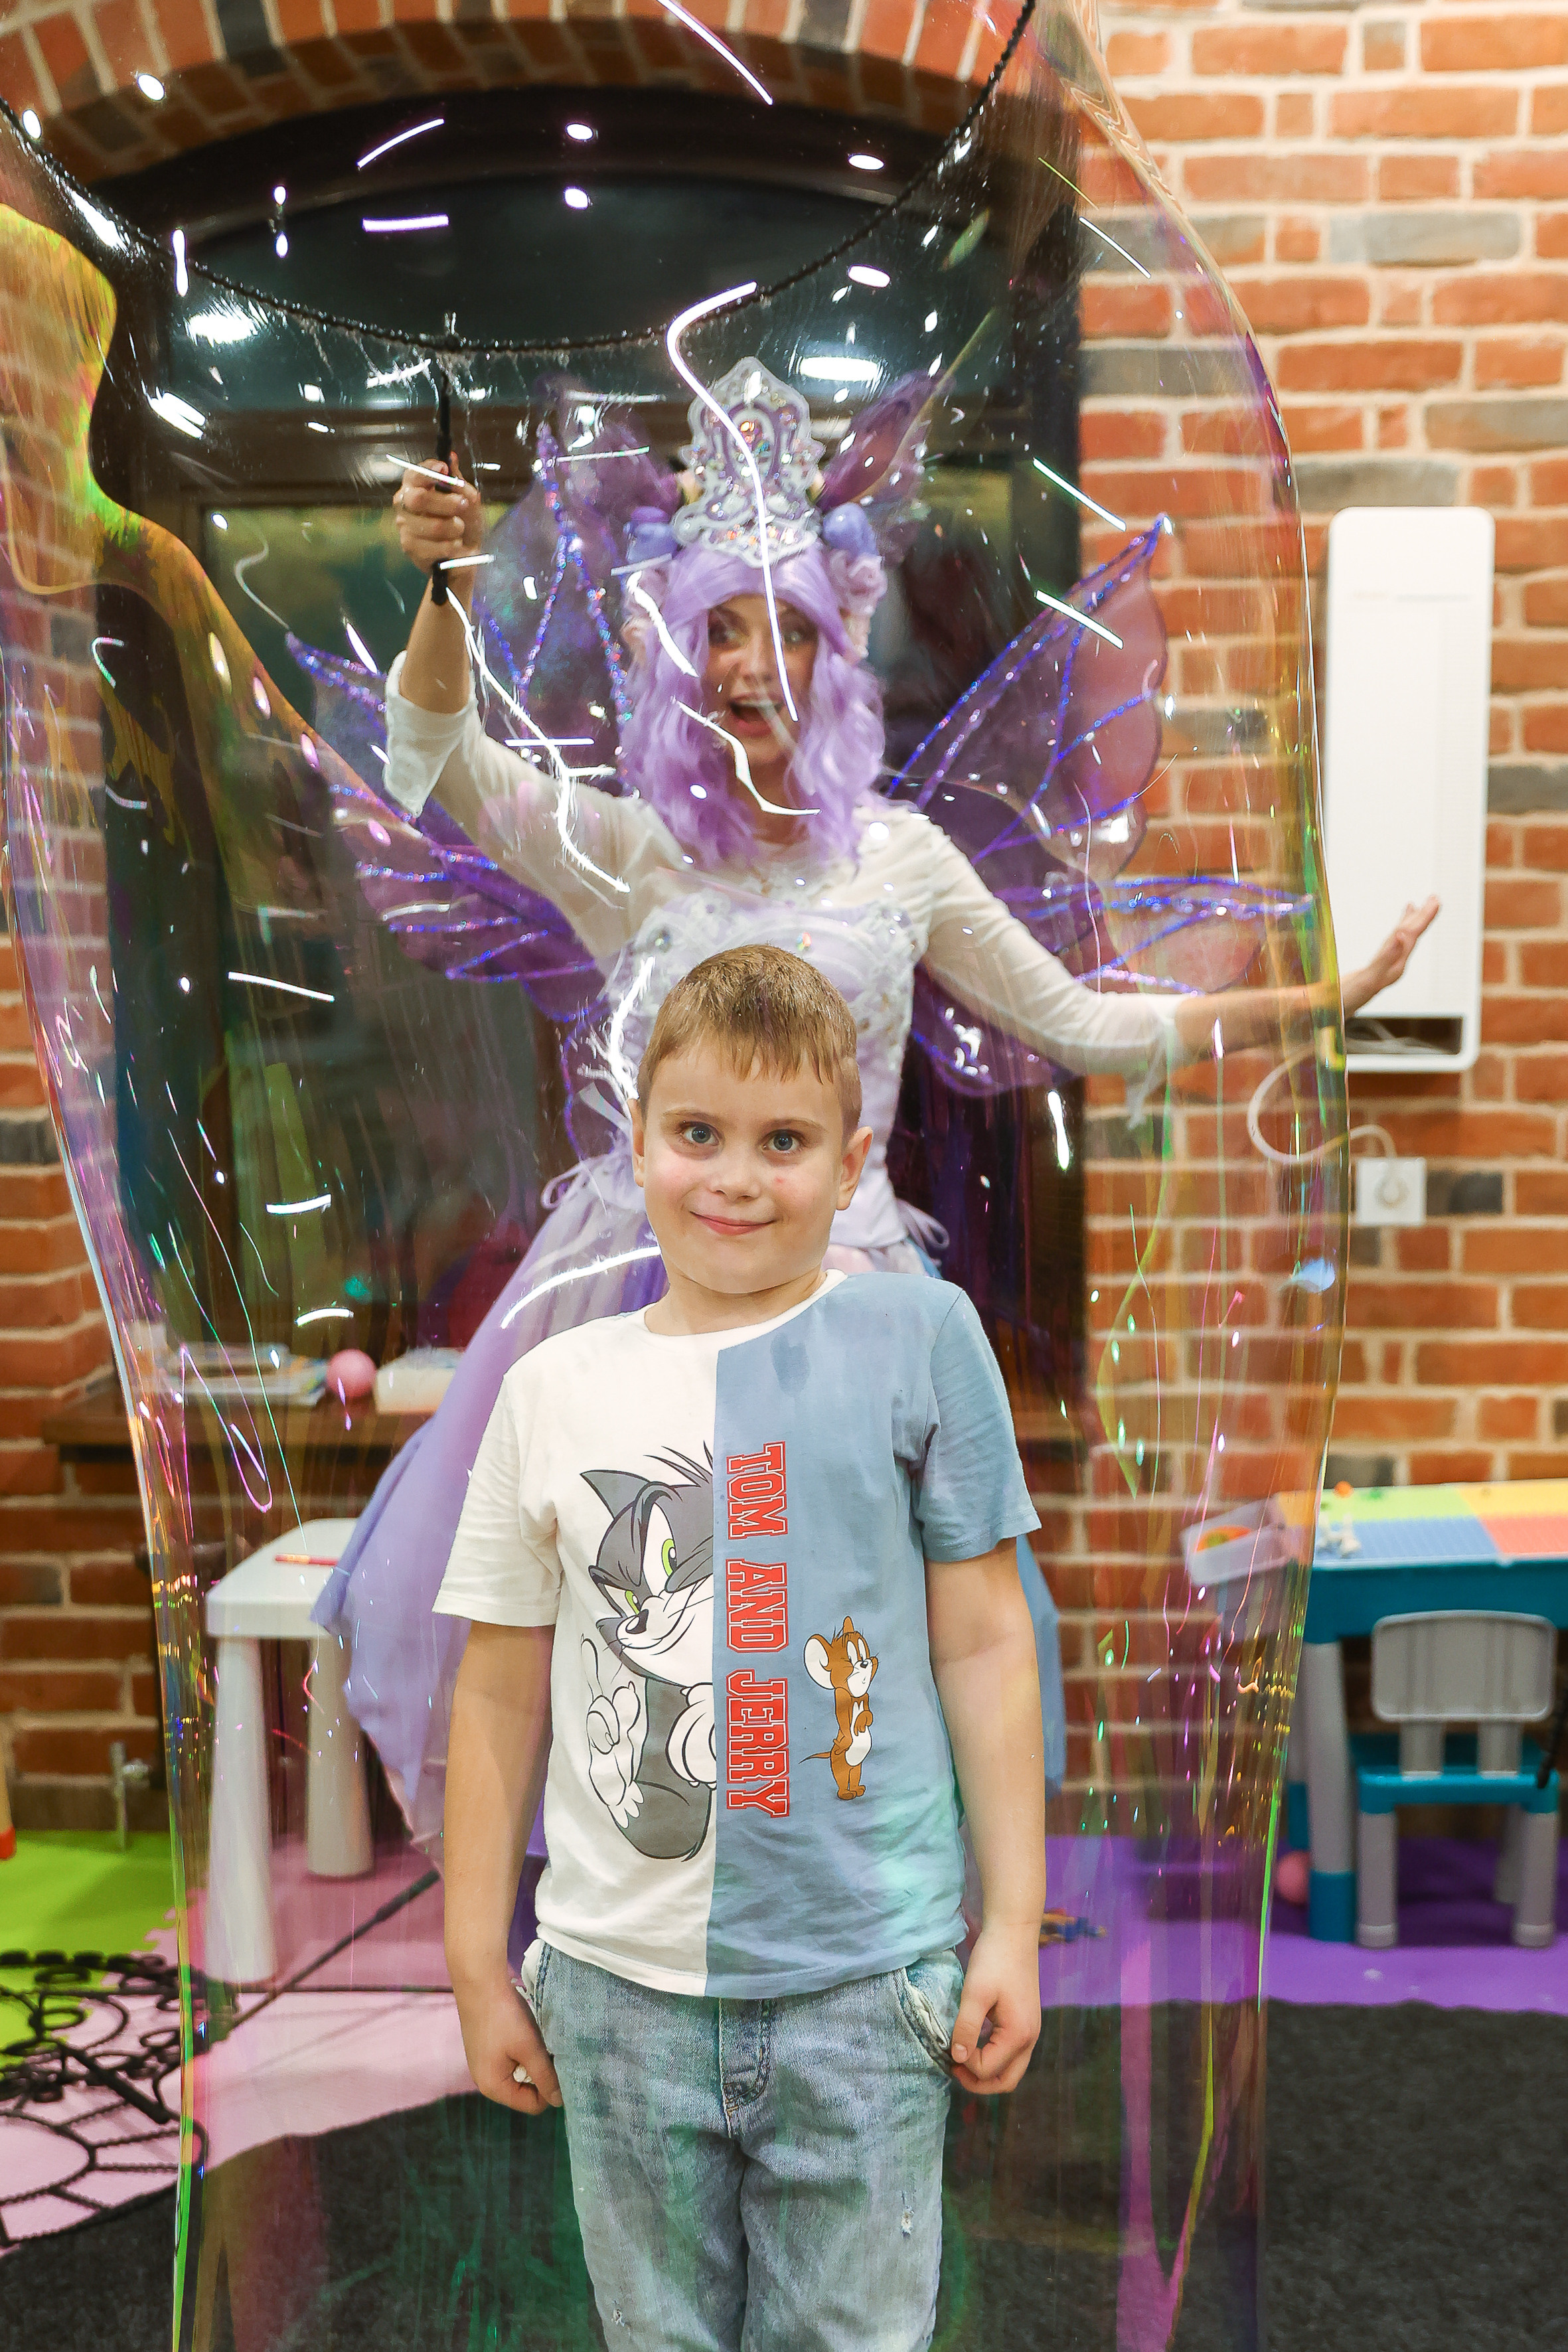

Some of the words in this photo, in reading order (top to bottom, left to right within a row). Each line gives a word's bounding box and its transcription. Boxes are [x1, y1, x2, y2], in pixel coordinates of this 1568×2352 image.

[726, 1441, 788, 1539] TOM
[725, 1559, 789, 1652] AND
[726, 1669, 790, 1818] JERRY
